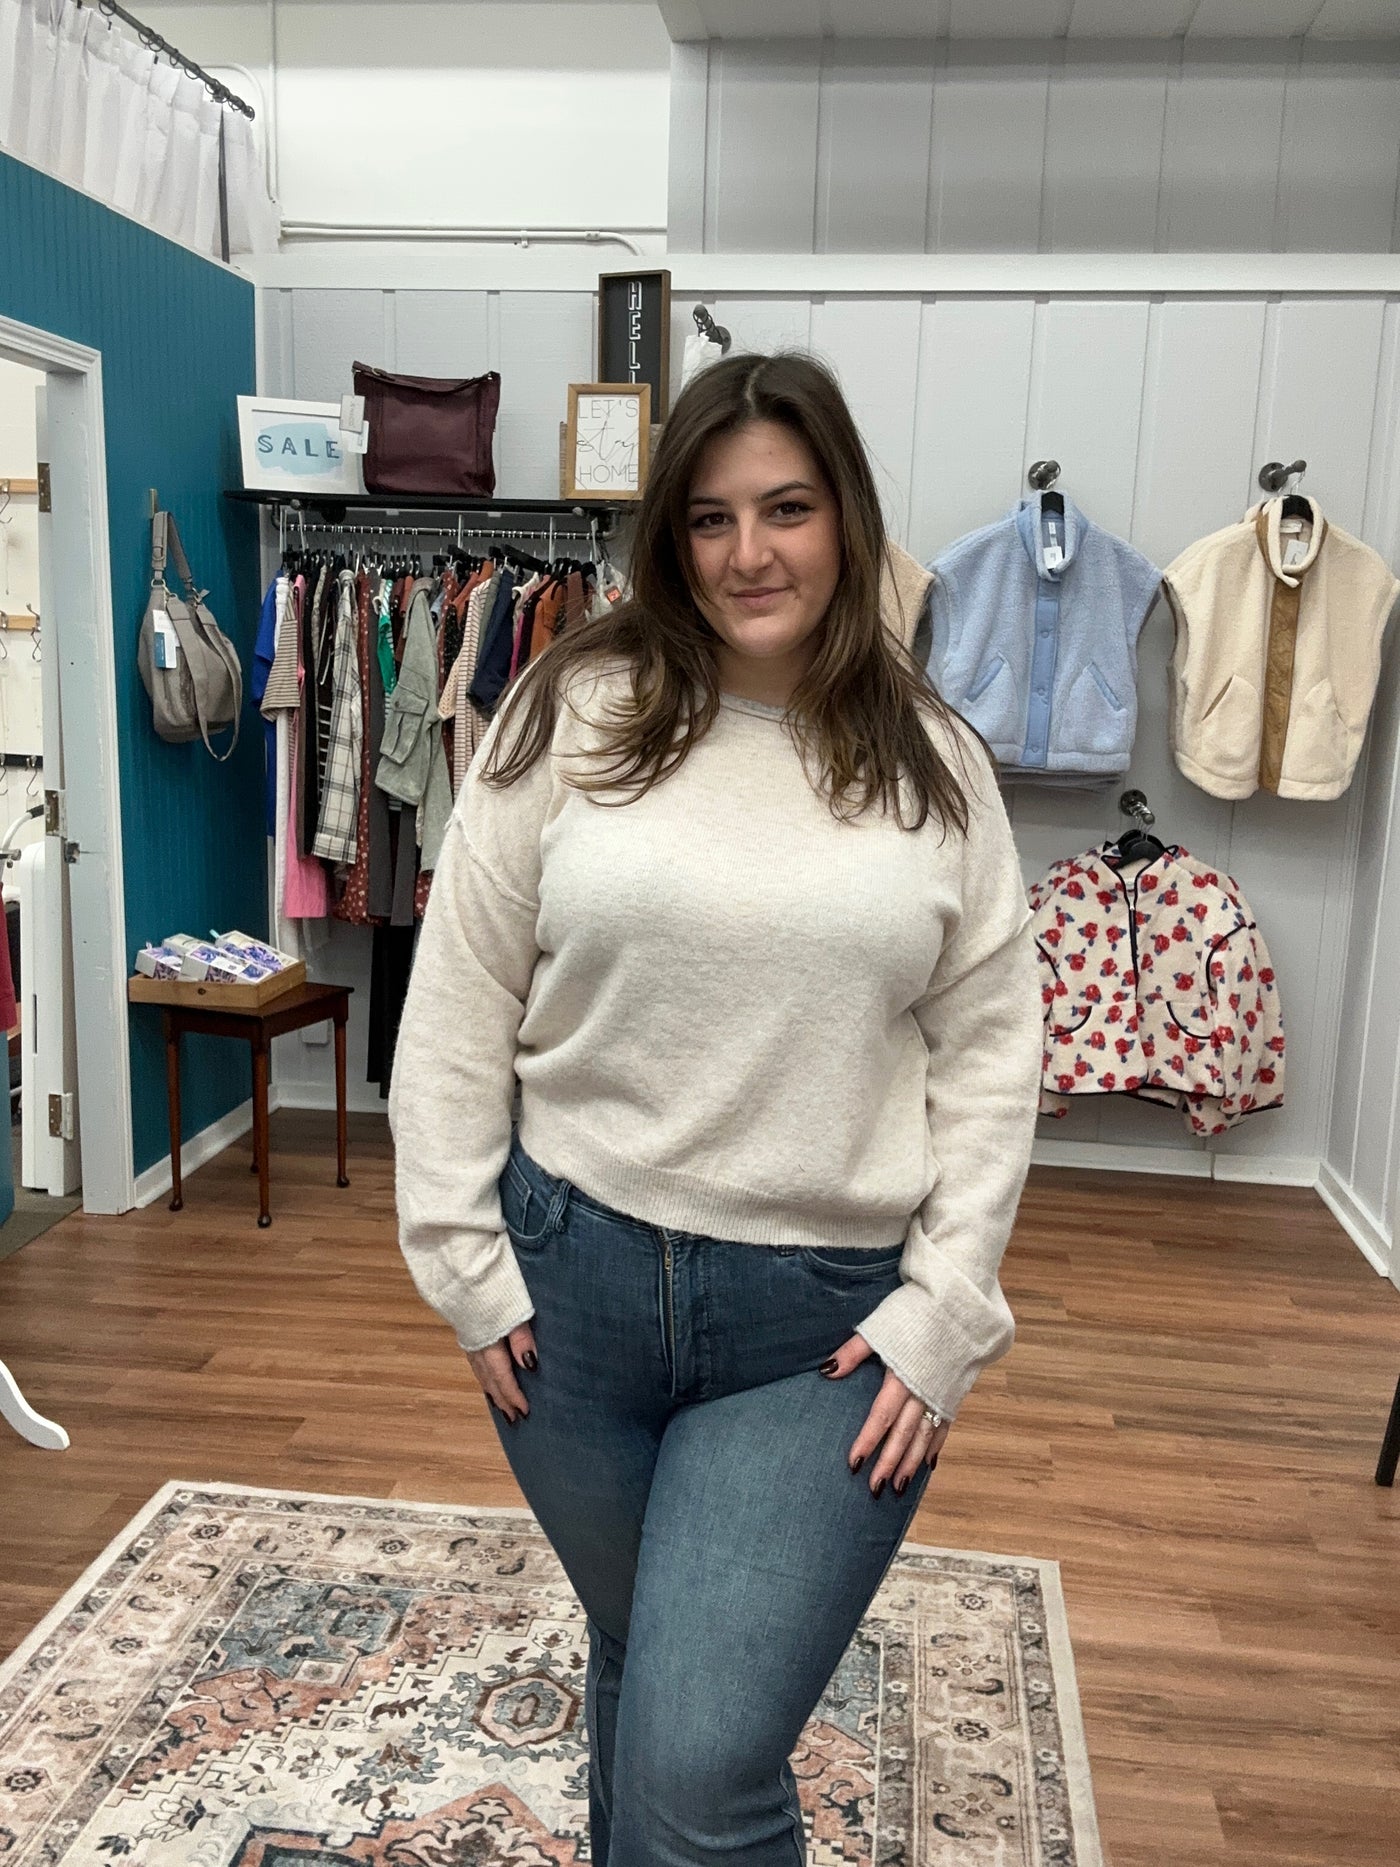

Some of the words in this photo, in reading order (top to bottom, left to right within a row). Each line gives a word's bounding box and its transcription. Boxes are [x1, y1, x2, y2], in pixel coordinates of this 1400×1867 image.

[578, 399, 638, 419] LET'S
[257, 434, 340, 459] SALE
[579, 464, 639, 483] HOME
